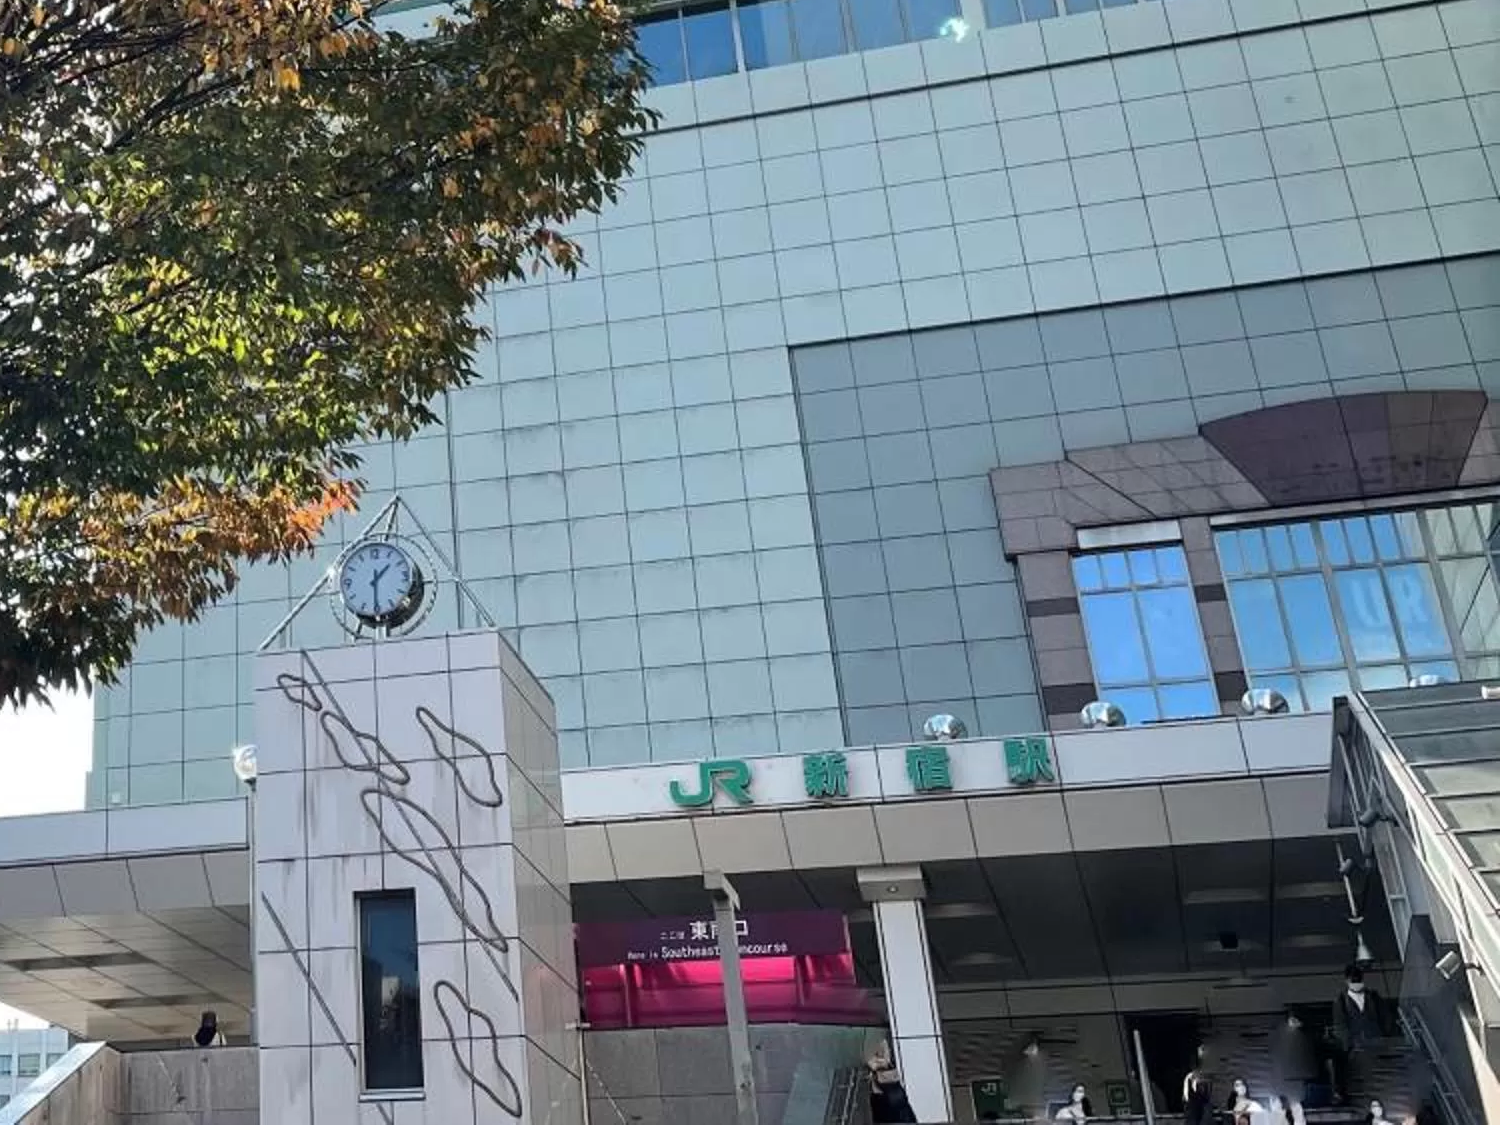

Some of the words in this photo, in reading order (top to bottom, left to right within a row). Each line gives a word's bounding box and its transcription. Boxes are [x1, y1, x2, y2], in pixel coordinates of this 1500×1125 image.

[669, 758, 754, 807] JR
[661, 944, 721, 959] Southeast
[737, 942, 789, 954] ncourse
